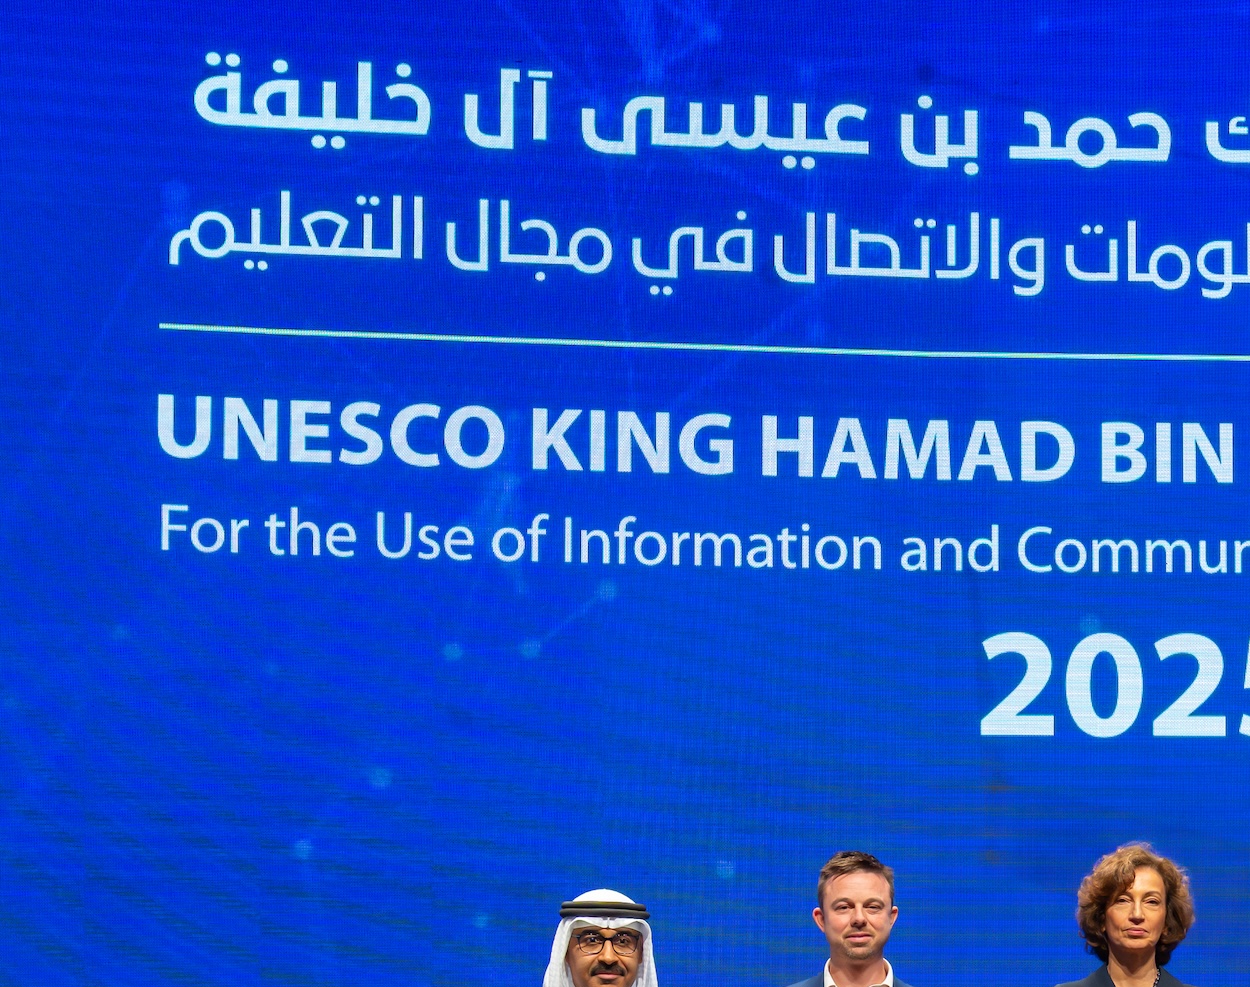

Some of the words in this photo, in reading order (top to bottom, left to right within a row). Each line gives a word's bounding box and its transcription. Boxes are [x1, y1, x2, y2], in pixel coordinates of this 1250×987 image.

[193, 52, 431, 150] خليفة
[464, 68, 553, 150] آل
[581, 95, 870, 170] عيسى
[900, 95, 979, 175] بن
[1009, 111, 1172, 168] حمد
[169, 190, 424, 271] التعليم
[446, 198, 613, 282] مجال
[632, 226, 753, 296] في
[773, 211, 1046, 297] والاتصال
[157, 393, 505, 471] UNESCO
[532, 407, 734, 476] KING
[761, 414, 1076, 482] HAMAD
[1101, 421, 1234, 483] BIN
[161, 503, 250, 553] For
[264, 513, 357, 558] the
[376, 511, 475, 561] Use
[491, 512, 550, 563] of
[564, 517, 882, 572] Information
[900, 524, 1000, 573] and
